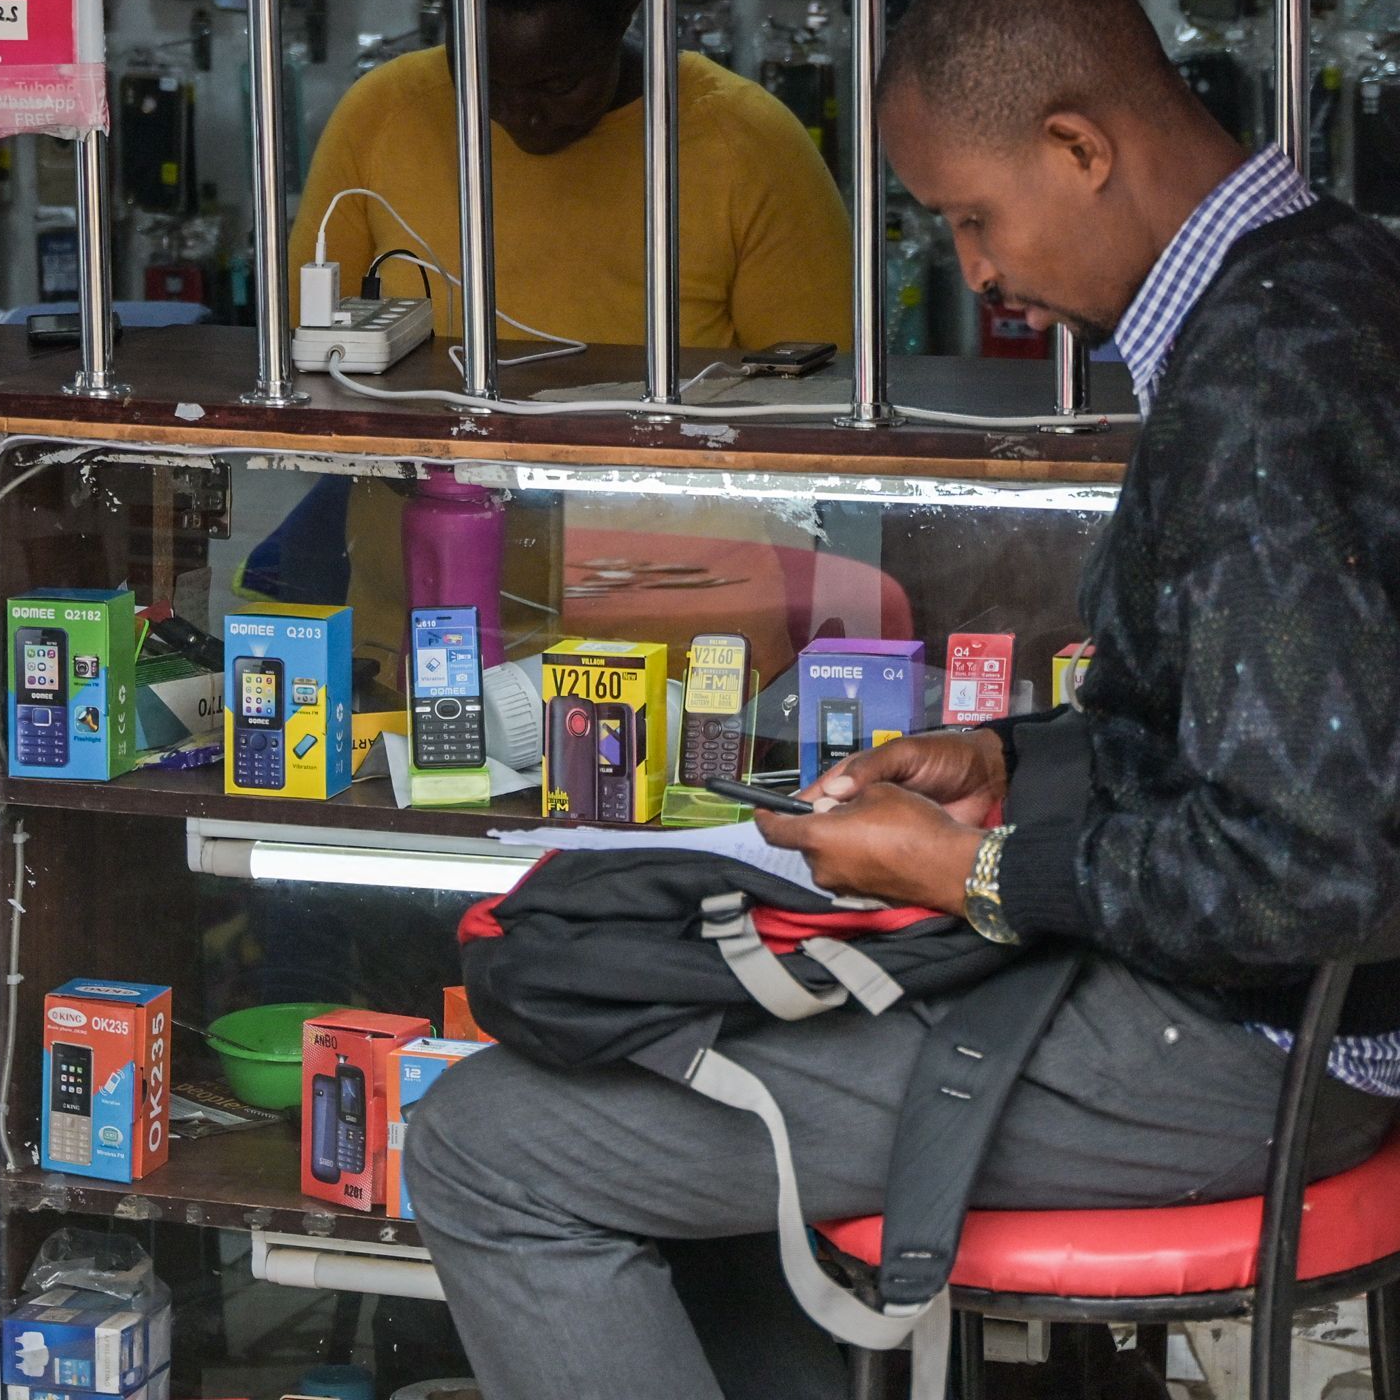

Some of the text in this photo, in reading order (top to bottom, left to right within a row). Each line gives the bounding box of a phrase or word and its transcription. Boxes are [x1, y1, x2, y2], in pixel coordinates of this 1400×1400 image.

[14, 112, 56, 127] FREE
[64, 609, 101, 621] Q2182
[286, 626, 322, 639] Q203
[694, 647, 734, 665] V2160
[954, 646, 970, 658] Q4
[883, 667, 904, 681] Q4
[552, 668, 622, 699] V2160
[702, 674, 727, 690] FM
[548, 803, 570, 812] FM
[91, 1016, 129, 1036] OK235
[403, 1068, 422, 1079] 12
[148, 1011, 165, 1152] OK235
